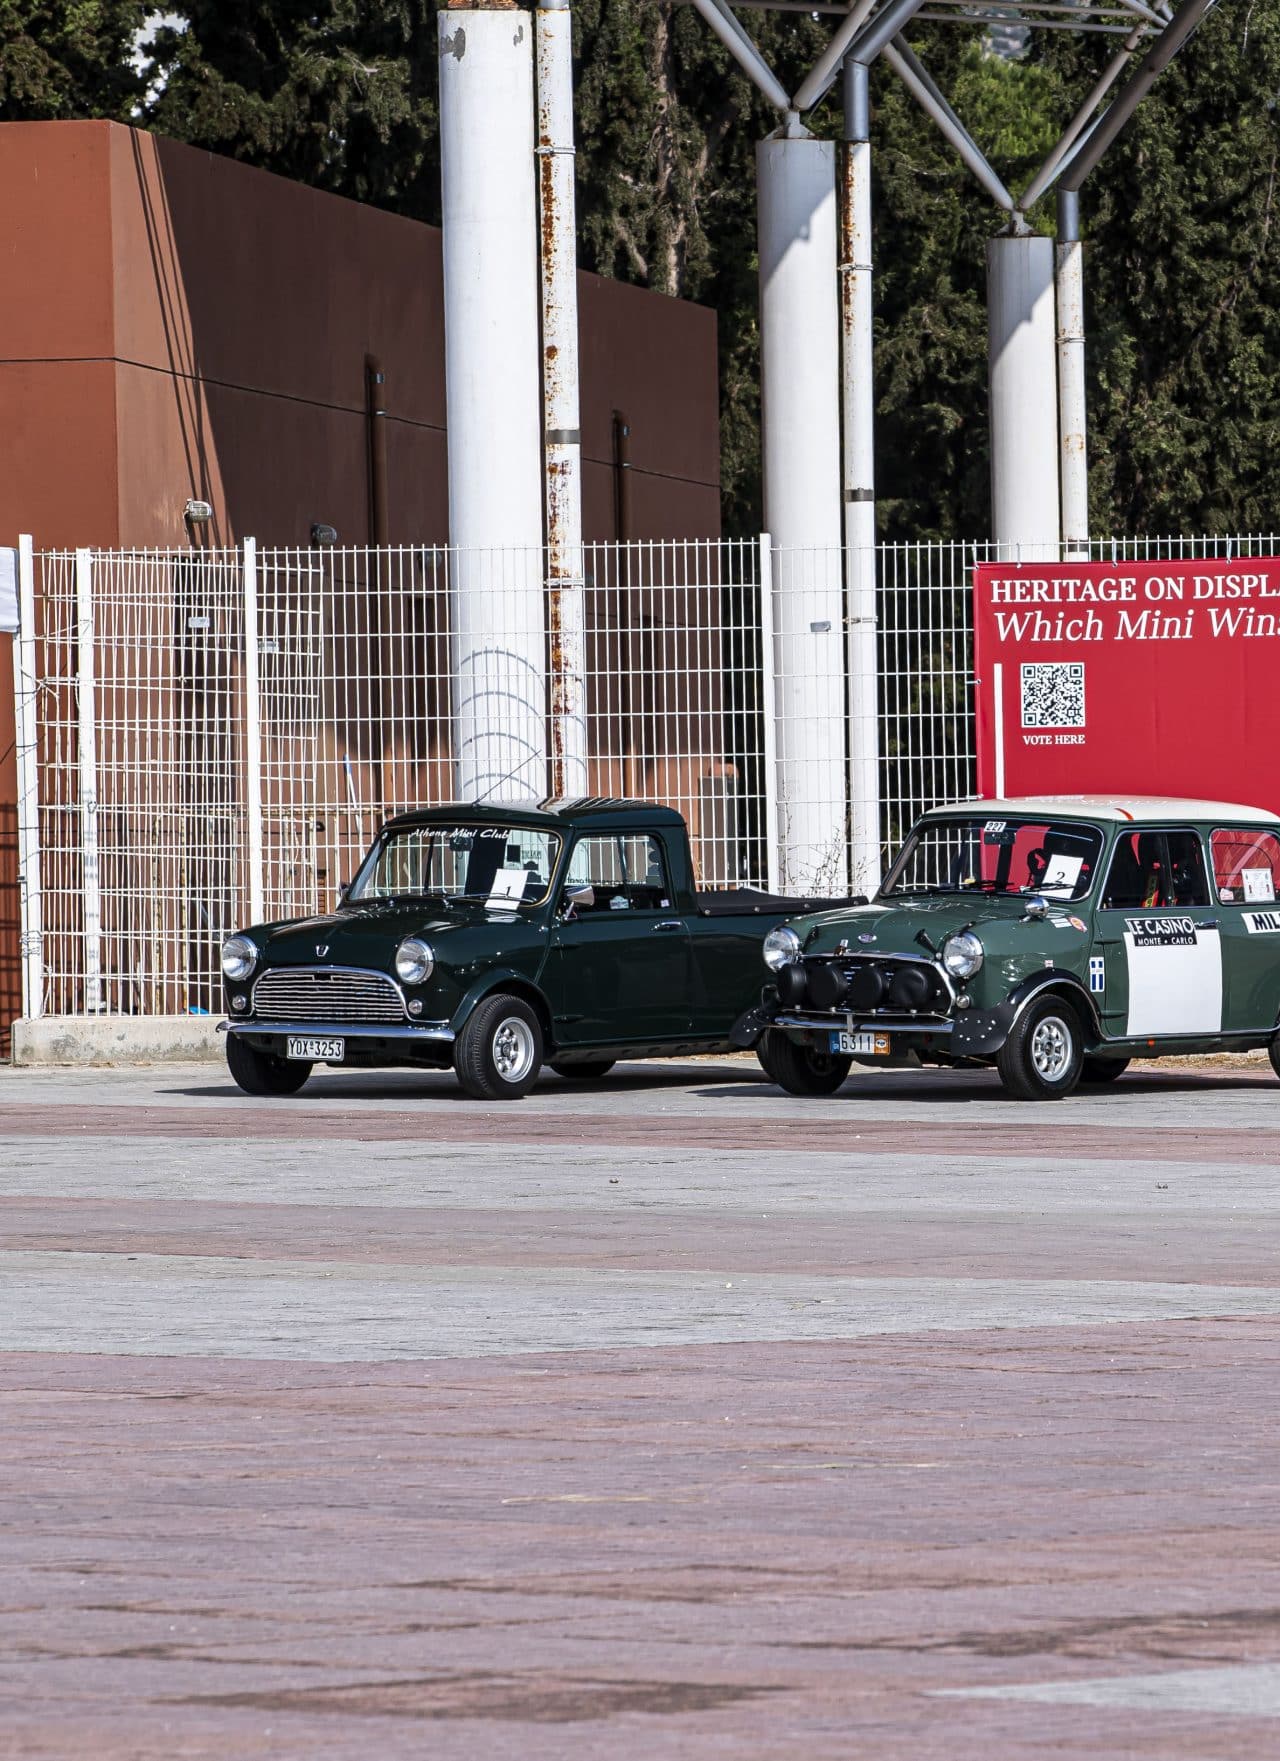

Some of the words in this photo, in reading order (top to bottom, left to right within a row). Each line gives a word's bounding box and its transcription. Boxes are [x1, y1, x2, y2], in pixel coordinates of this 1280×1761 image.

[990, 578, 1137, 603] HERITAGE
[1144, 576, 1185, 600] ON
[993, 609, 1104, 641] Which
[1114, 608, 1195, 640] Mini
[1022, 735, 1053, 745] VOTE
[1055, 734, 1086, 745] HERE
[449, 827, 478, 839] Mini
[480, 828, 511, 839] Club
[984, 822, 1005, 832] 227
[1055, 871, 1066, 884] 2
[1127, 920, 1145, 935] LE
[1145, 918, 1195, 935] CASINO
[1137, 937, 1162, 946] MONTE
[1171, 936, 1194, 945] CARLO
[841, 1033, 872, 1051] 6311
